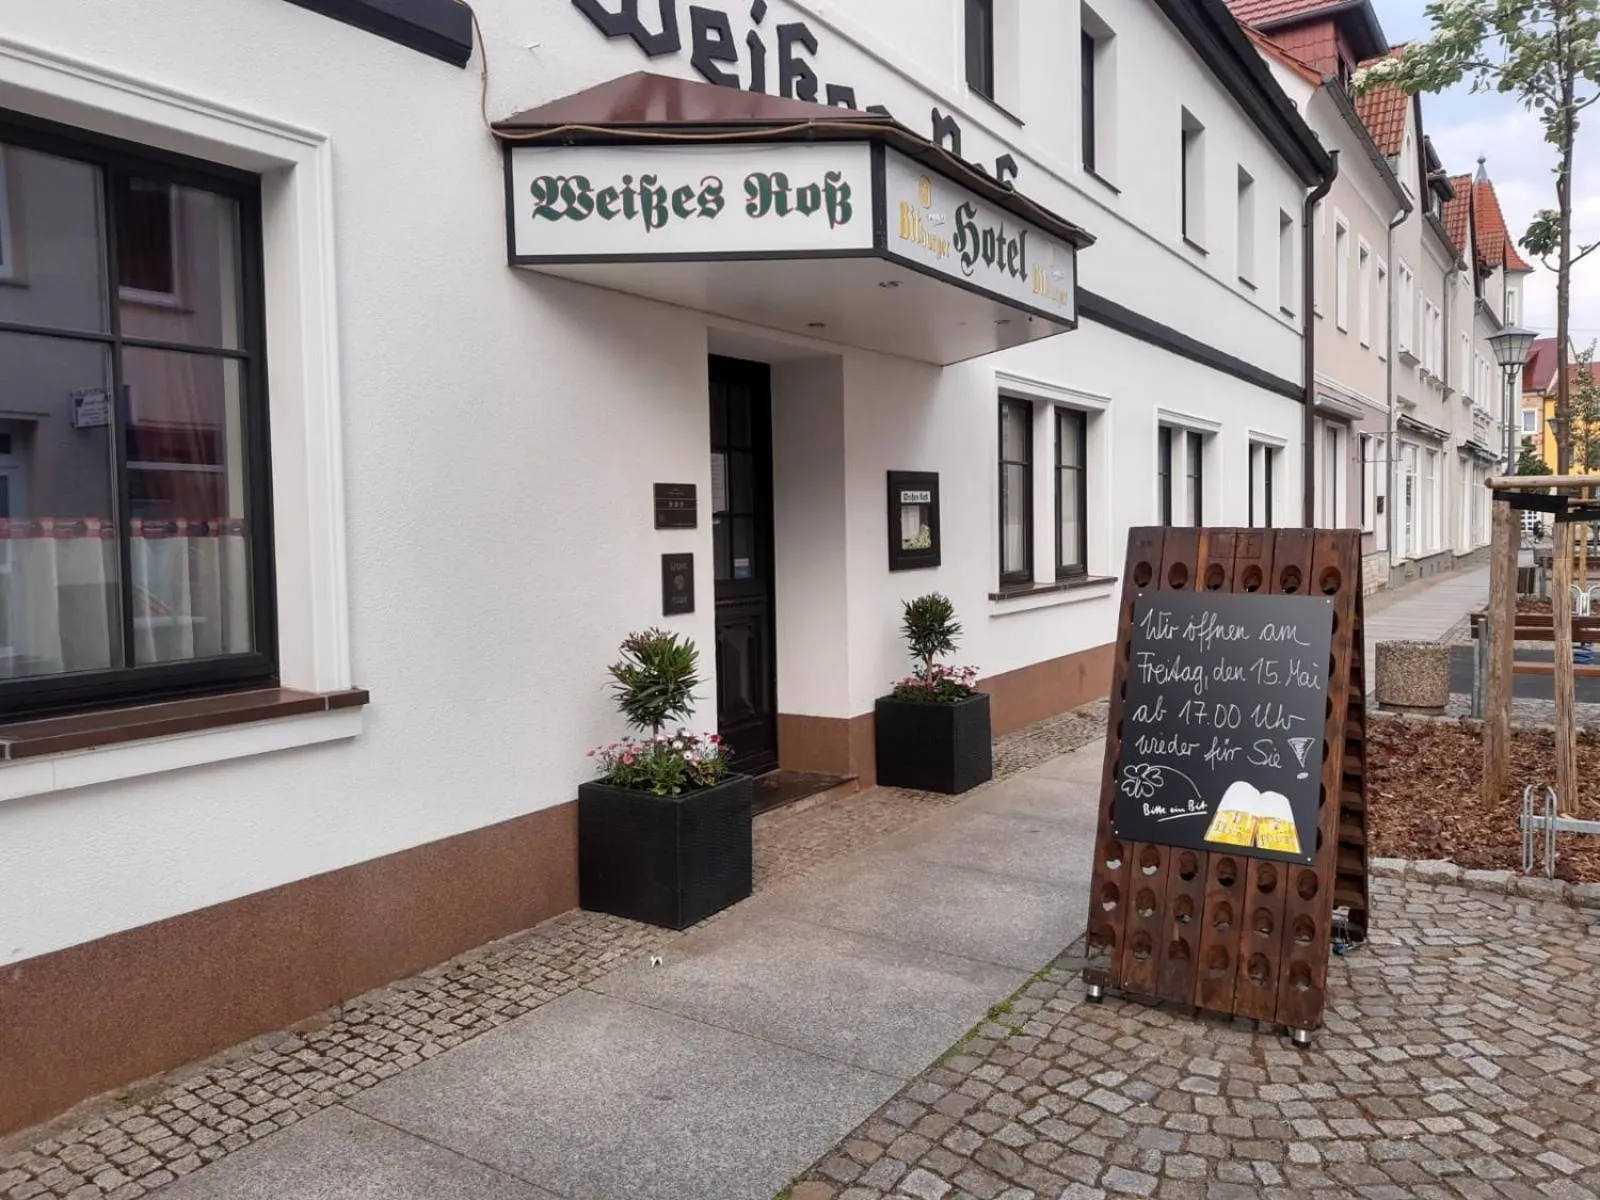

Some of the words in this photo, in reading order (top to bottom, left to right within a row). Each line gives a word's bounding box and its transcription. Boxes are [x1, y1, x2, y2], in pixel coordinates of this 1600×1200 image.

[530, 174, 725, 233] Weißes
[743, 170, 853, 230] Roß
[952, 201, 1028, 283] Hotel
[1140, 608, 1179, 640] Wir
[1182, 610, 1249, 652] öffnen
[1258, 623, 1310, 646] am
[1136, 652, 1209, 695] Freitag,
[1213, 657, 1246, 682] den
[1250, 657, 1282, 685] 15.
[1284, 658, 1321, 690] Mai
[1132, 695, 1167, 723] ab
[1178, 700, 1242, 729] 17.00
[1250, 702, 1306, 730] Uhr
[1135, 732, 1200, 756] wieder
[1203, 735, 1242, 771] für
[1246, 738, 1282, 768] Sie
[1143, 802, 1167, 817] Bitte
[1187, 800, 1208, 812] Bit
